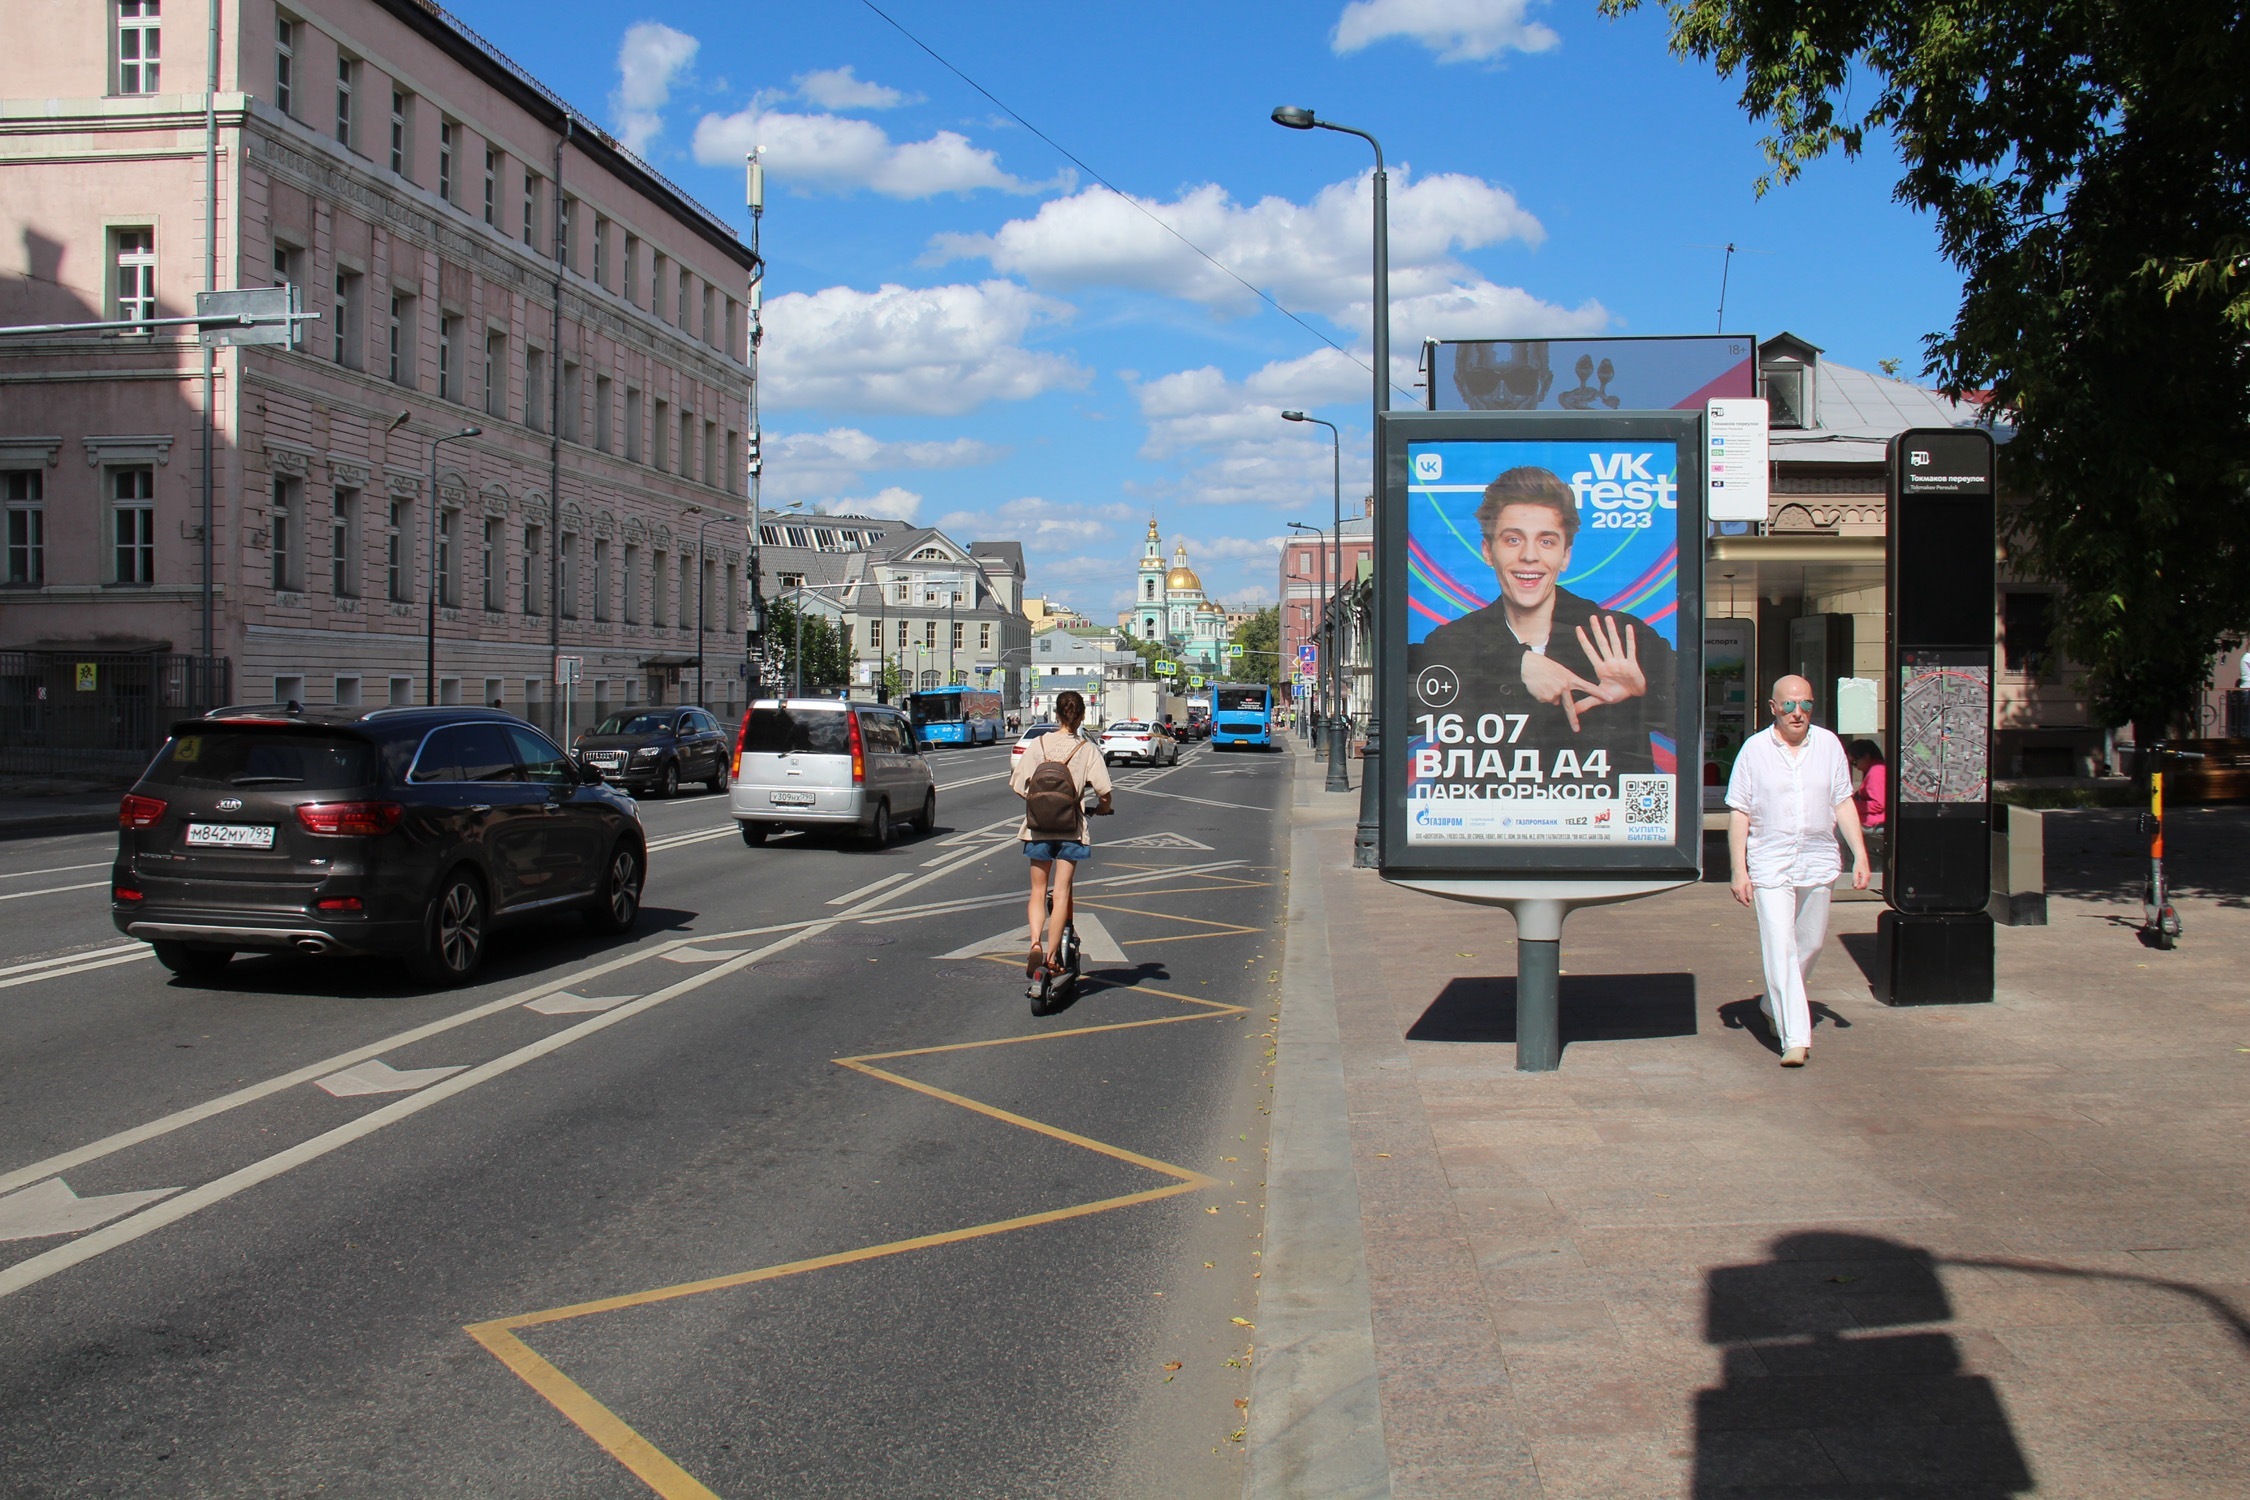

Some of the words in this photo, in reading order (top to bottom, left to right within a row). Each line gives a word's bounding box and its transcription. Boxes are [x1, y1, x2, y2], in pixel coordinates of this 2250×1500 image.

[1727, 344, 1747, 356] 18+
[1588, 453, 1653, 480] VK
[1910, 474, 1948, 483] Токмаков
[1948, 475, 1985, 484] переулок
[1571, 472, 1678, 510] fest
[1591, 511, 1652, 529] 2023
[1426, 678, 1452, 696] 0+
[1415, 714, 1530, 744] 16.07
[1415, 749, 1544, 783] ВЛАД
[1551, 749, 1611, 779] А4
[1415, 784, 1480, 800] ПАРК
[1486, 784, 1612, 800] ГОРЬКОГО
[1430, 817, 1463, 827] ГАЗПРОМ
[1565, 816, 1588, 826] TELE2
[250, 827, 270, 840] 799
